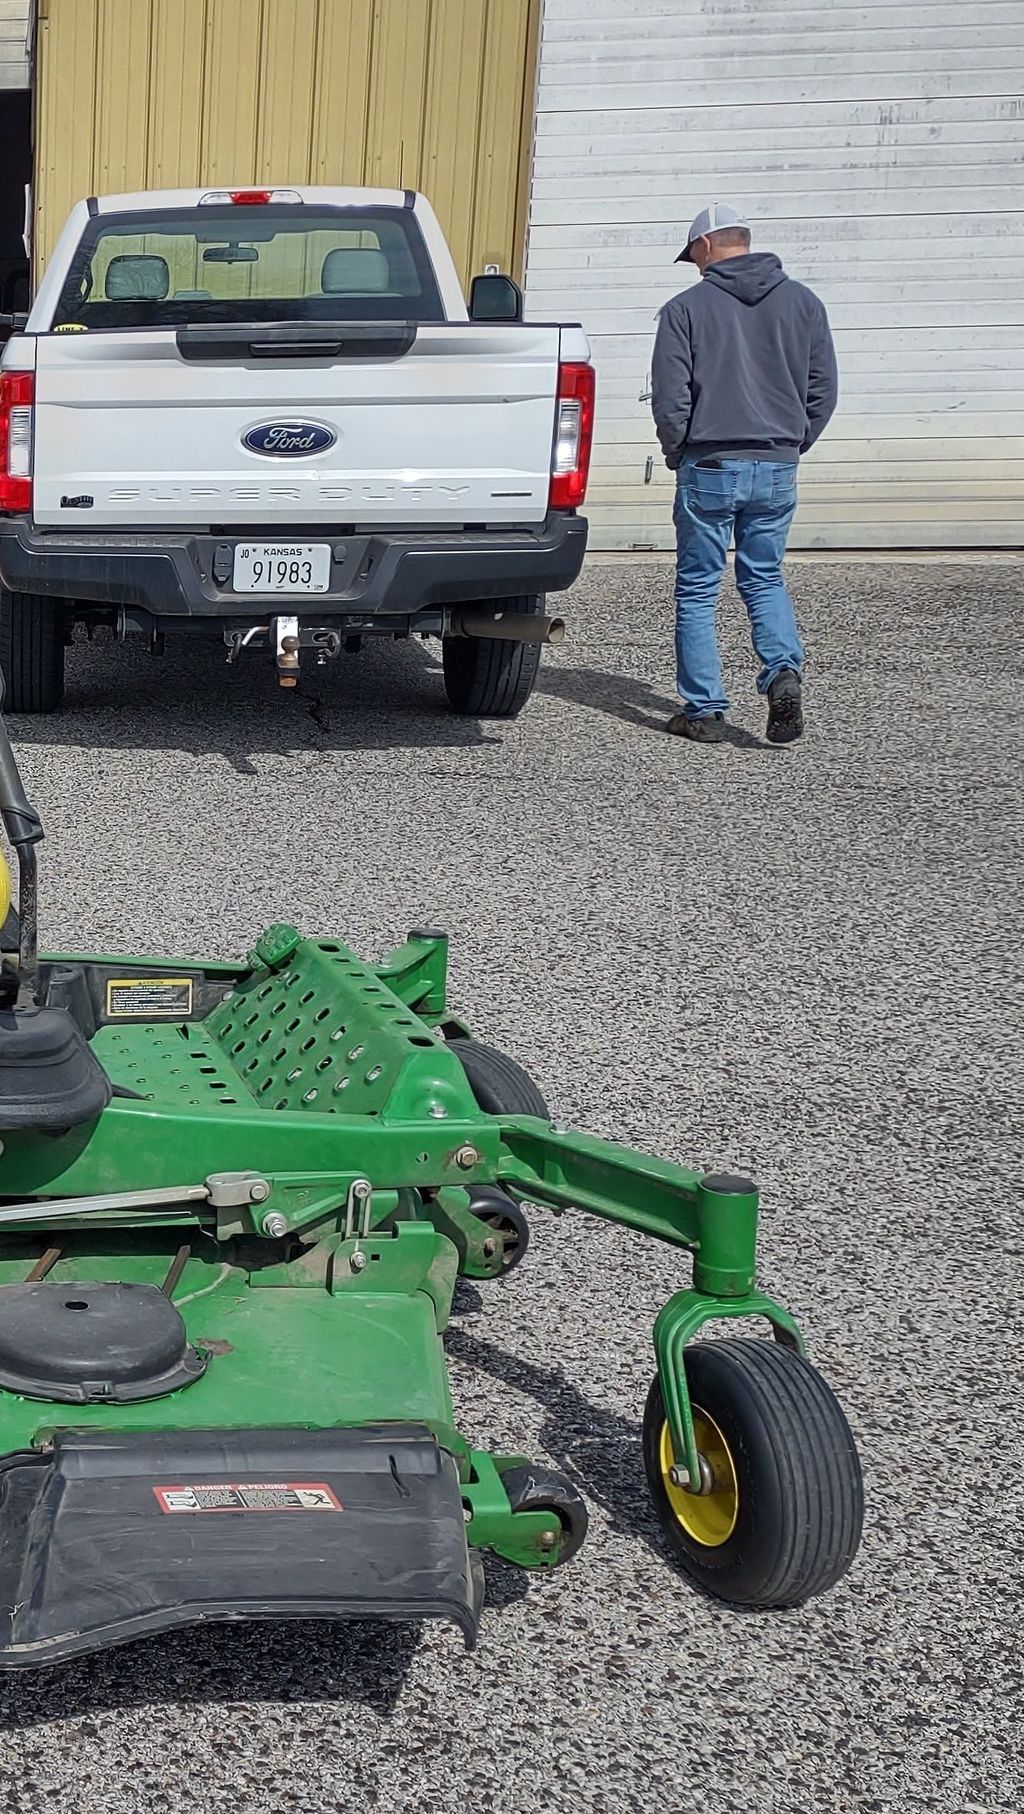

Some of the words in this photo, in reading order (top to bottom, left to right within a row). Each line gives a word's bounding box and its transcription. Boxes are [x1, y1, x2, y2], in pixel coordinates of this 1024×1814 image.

[263, 426, 317, 449] Ford
[107, 486, 301, 502] SUPER
[318, 485, 470, 502] DUTY
[263, 548, 303, 556] KANSAS
[253, 560, 312, 584] 91983
